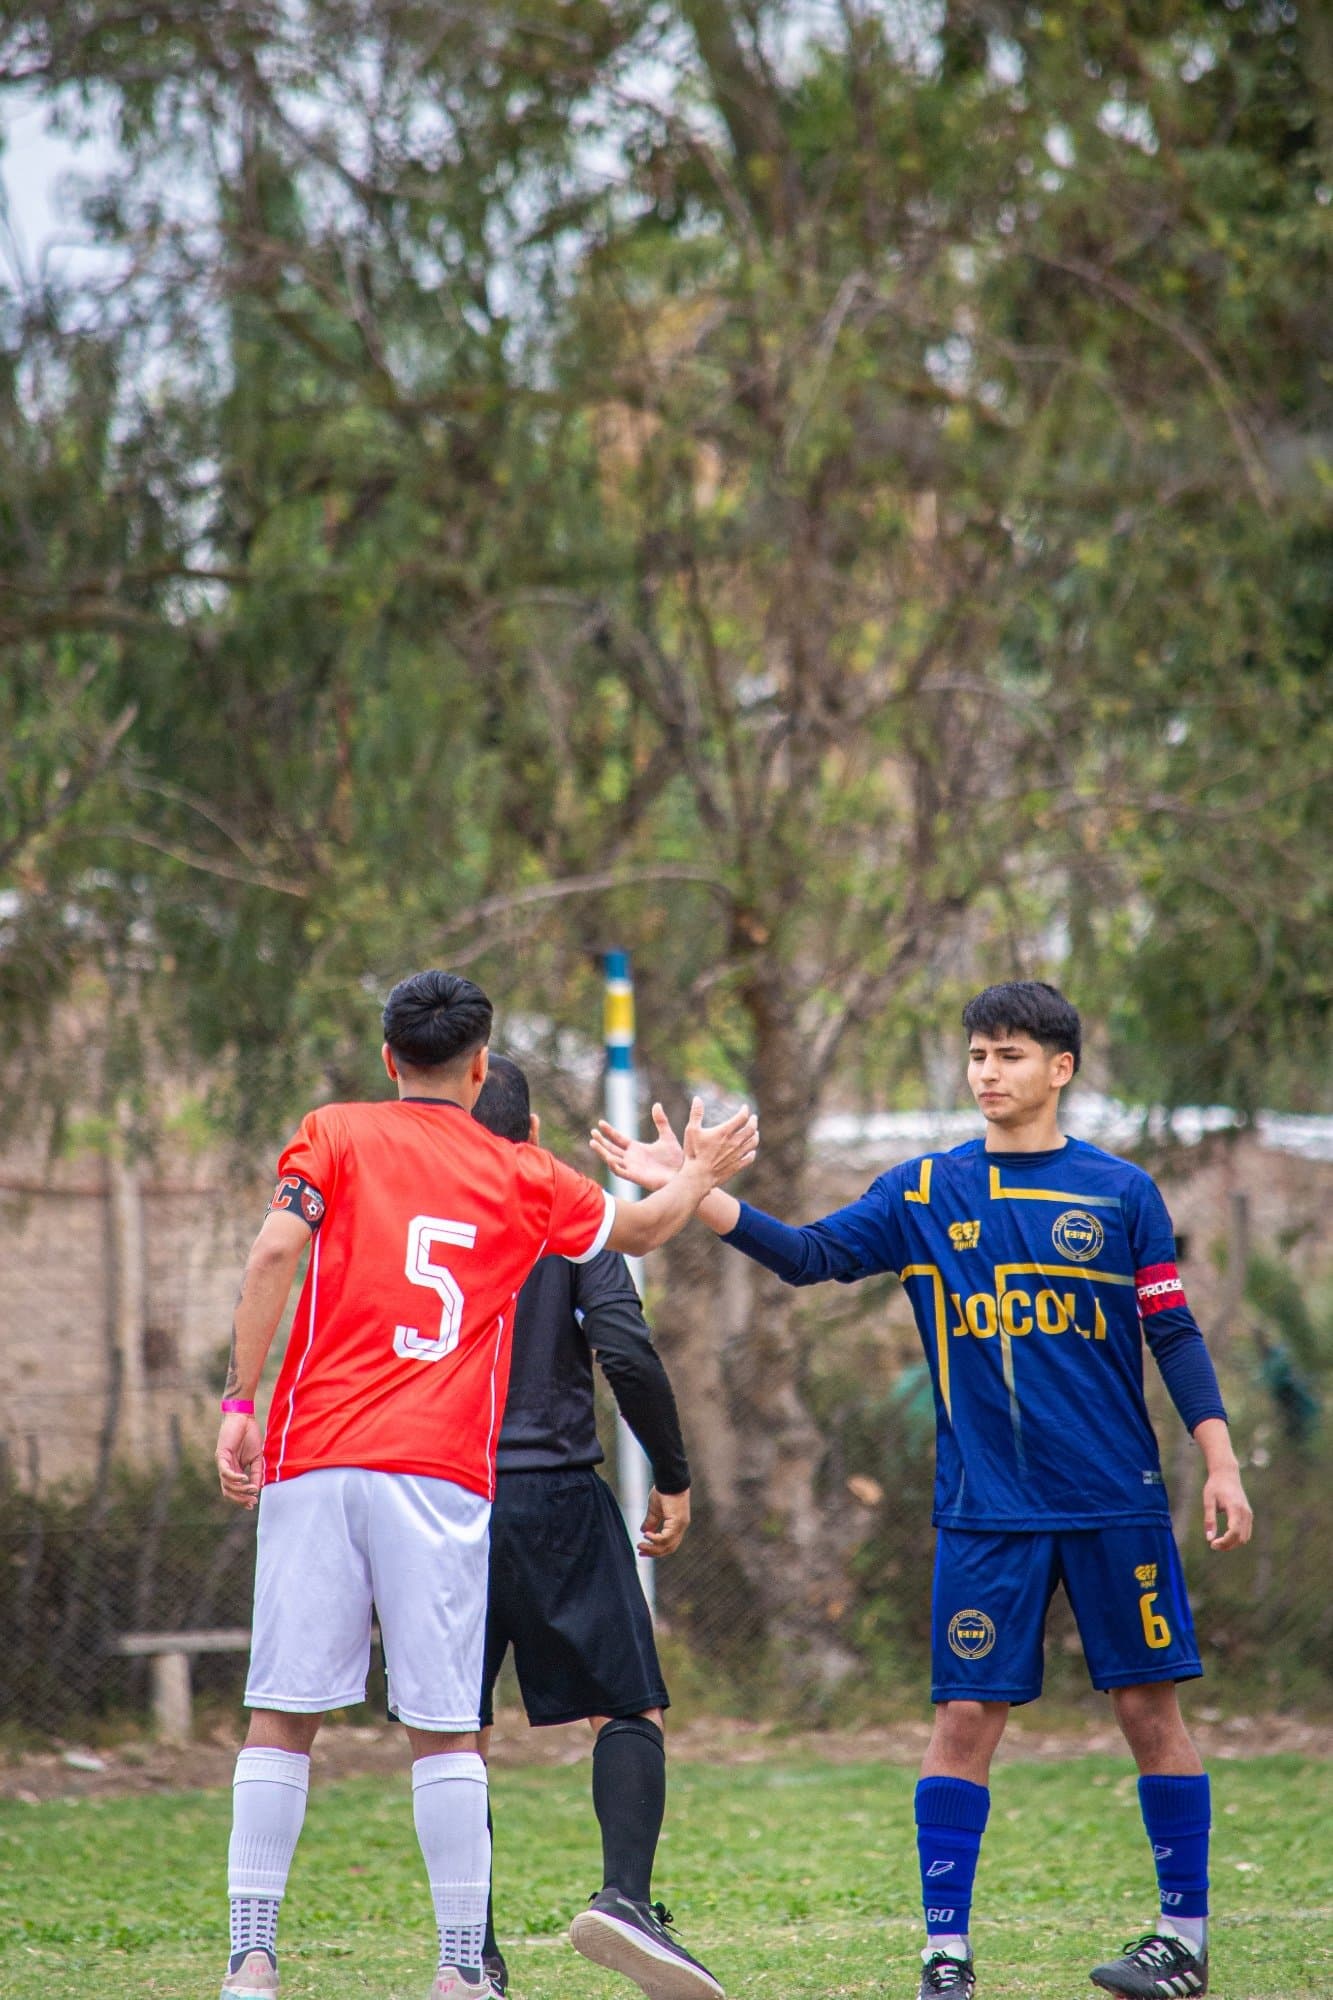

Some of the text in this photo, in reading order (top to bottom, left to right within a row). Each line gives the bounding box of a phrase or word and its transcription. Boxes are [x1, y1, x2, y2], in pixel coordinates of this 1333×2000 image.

[392, 1214, 478, 1362] 5
[1139, 1592, 1171, 1649] 6
[927, 1908, 955, 1922] GO
